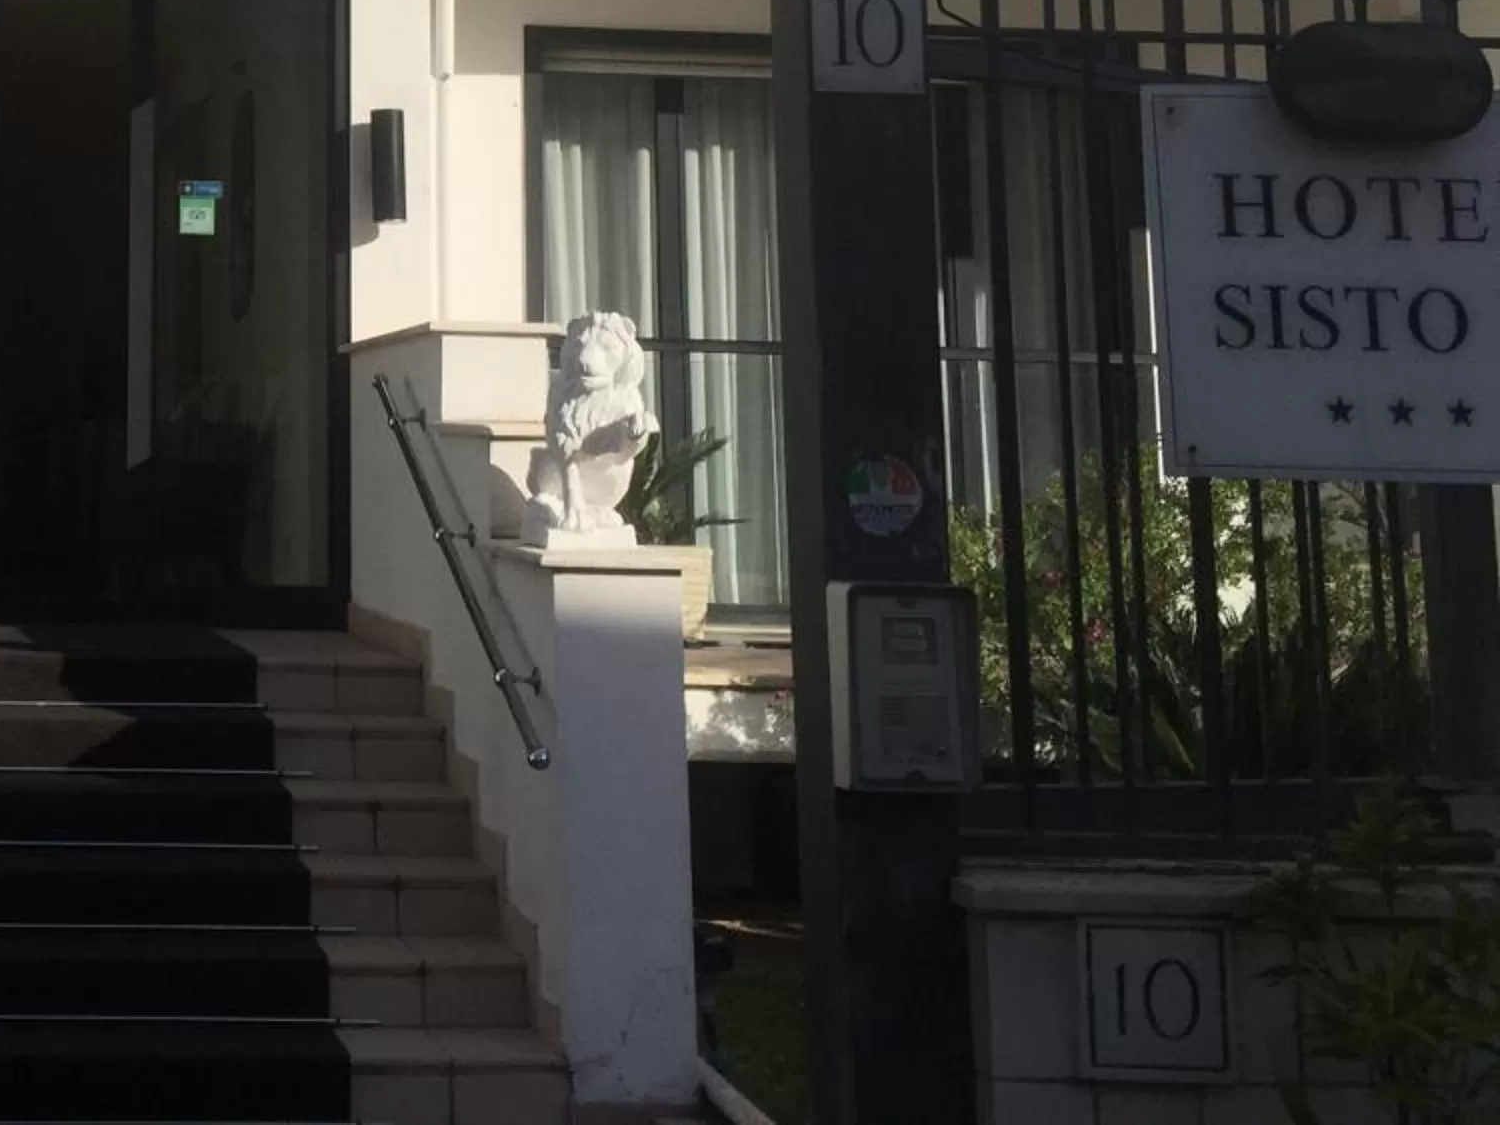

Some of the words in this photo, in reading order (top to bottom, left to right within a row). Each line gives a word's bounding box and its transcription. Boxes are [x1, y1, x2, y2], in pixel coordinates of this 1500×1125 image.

[1212, 172, 1500, 243] HOTE
[1213, 283, 1470, 354] SISTO
[1115, 958, 1200, 1042] 10
